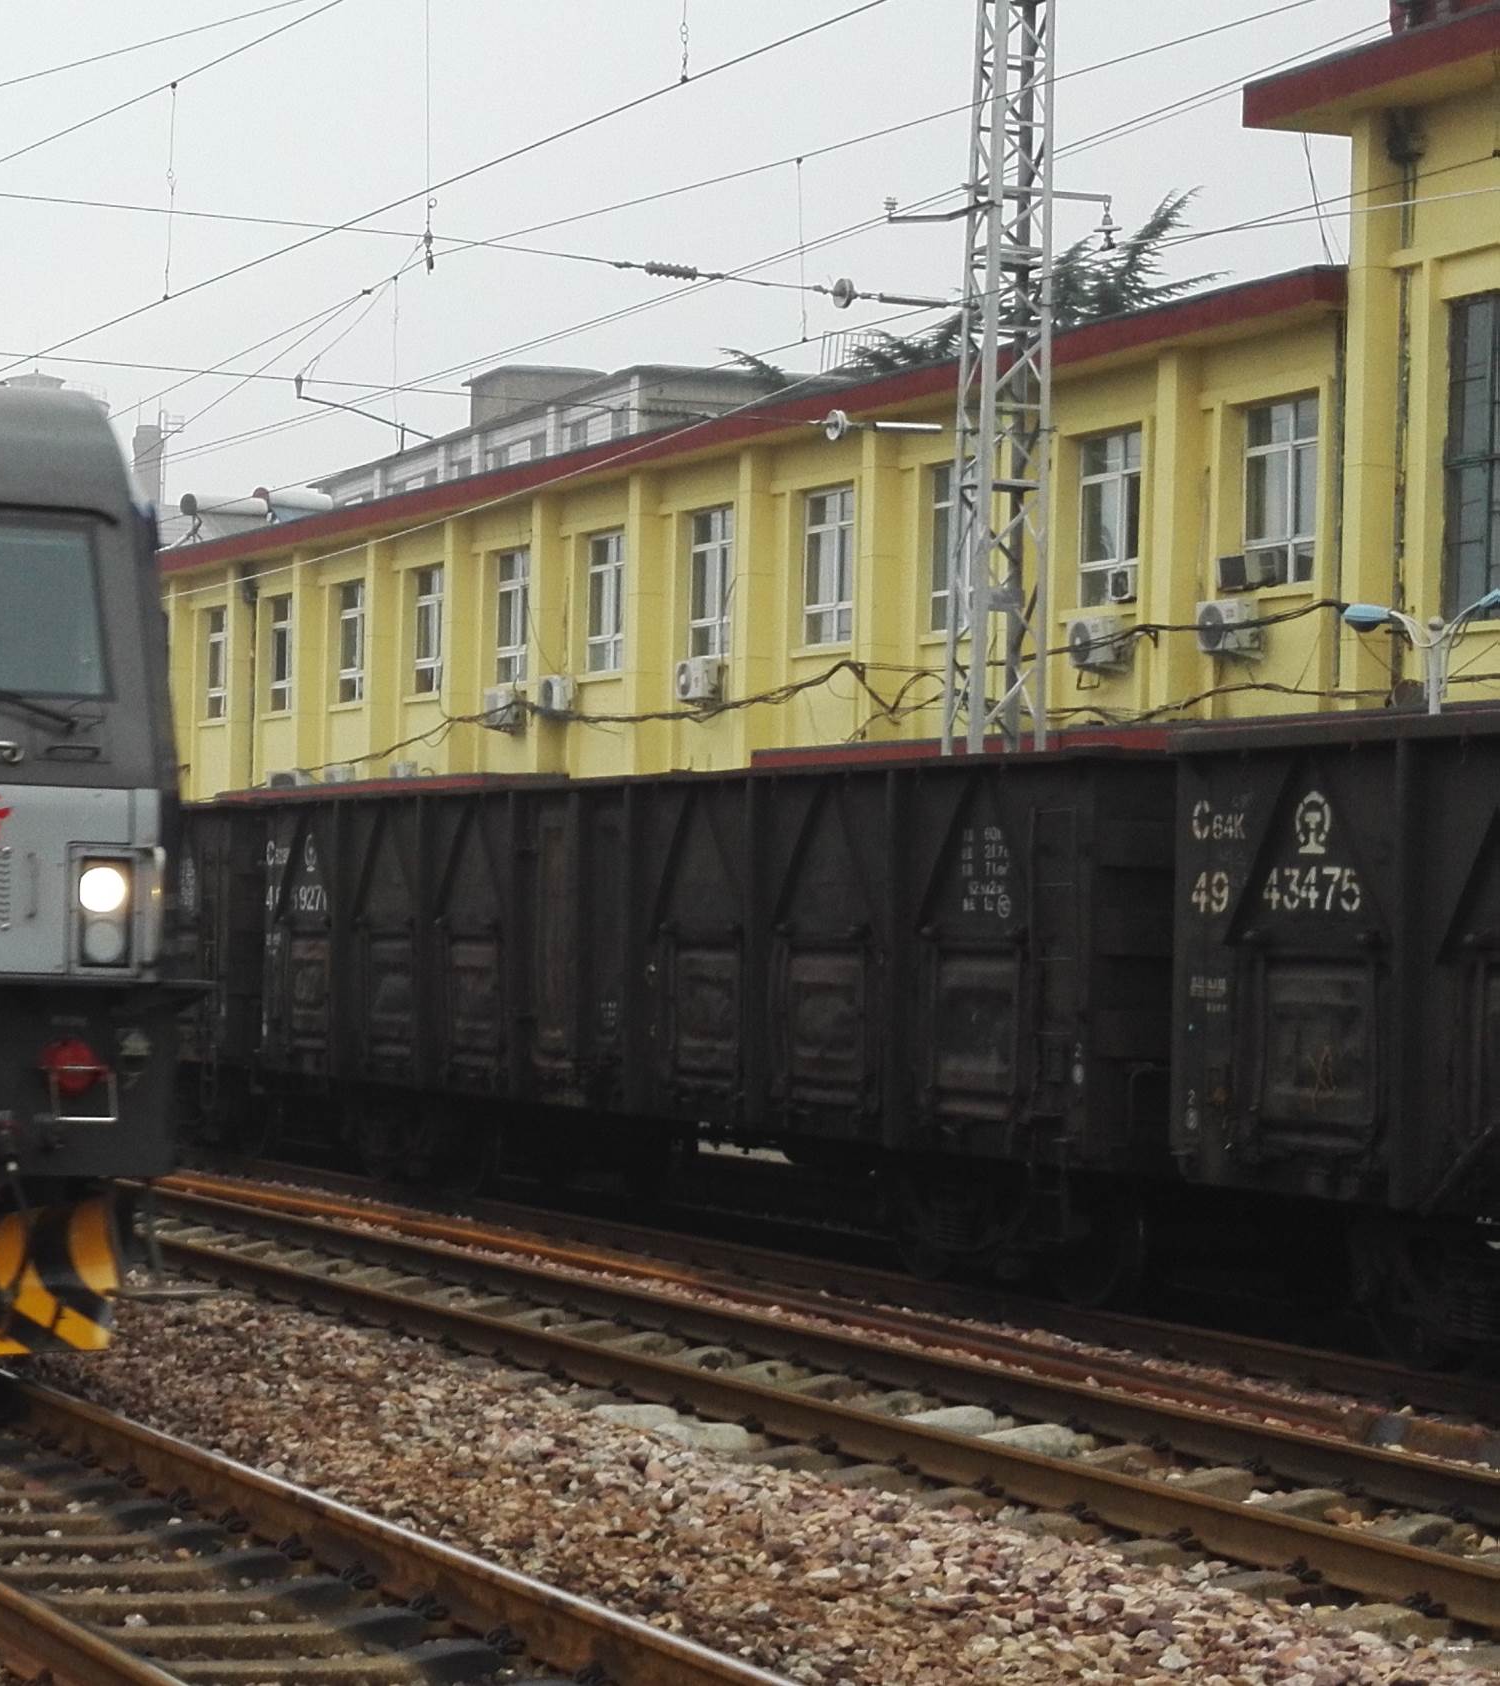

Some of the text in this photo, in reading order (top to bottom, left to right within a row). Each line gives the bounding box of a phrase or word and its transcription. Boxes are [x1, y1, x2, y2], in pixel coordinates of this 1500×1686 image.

[1192, 799, 1245, 840] C64K
[1192, 866, 1360, 913] 49 43475
